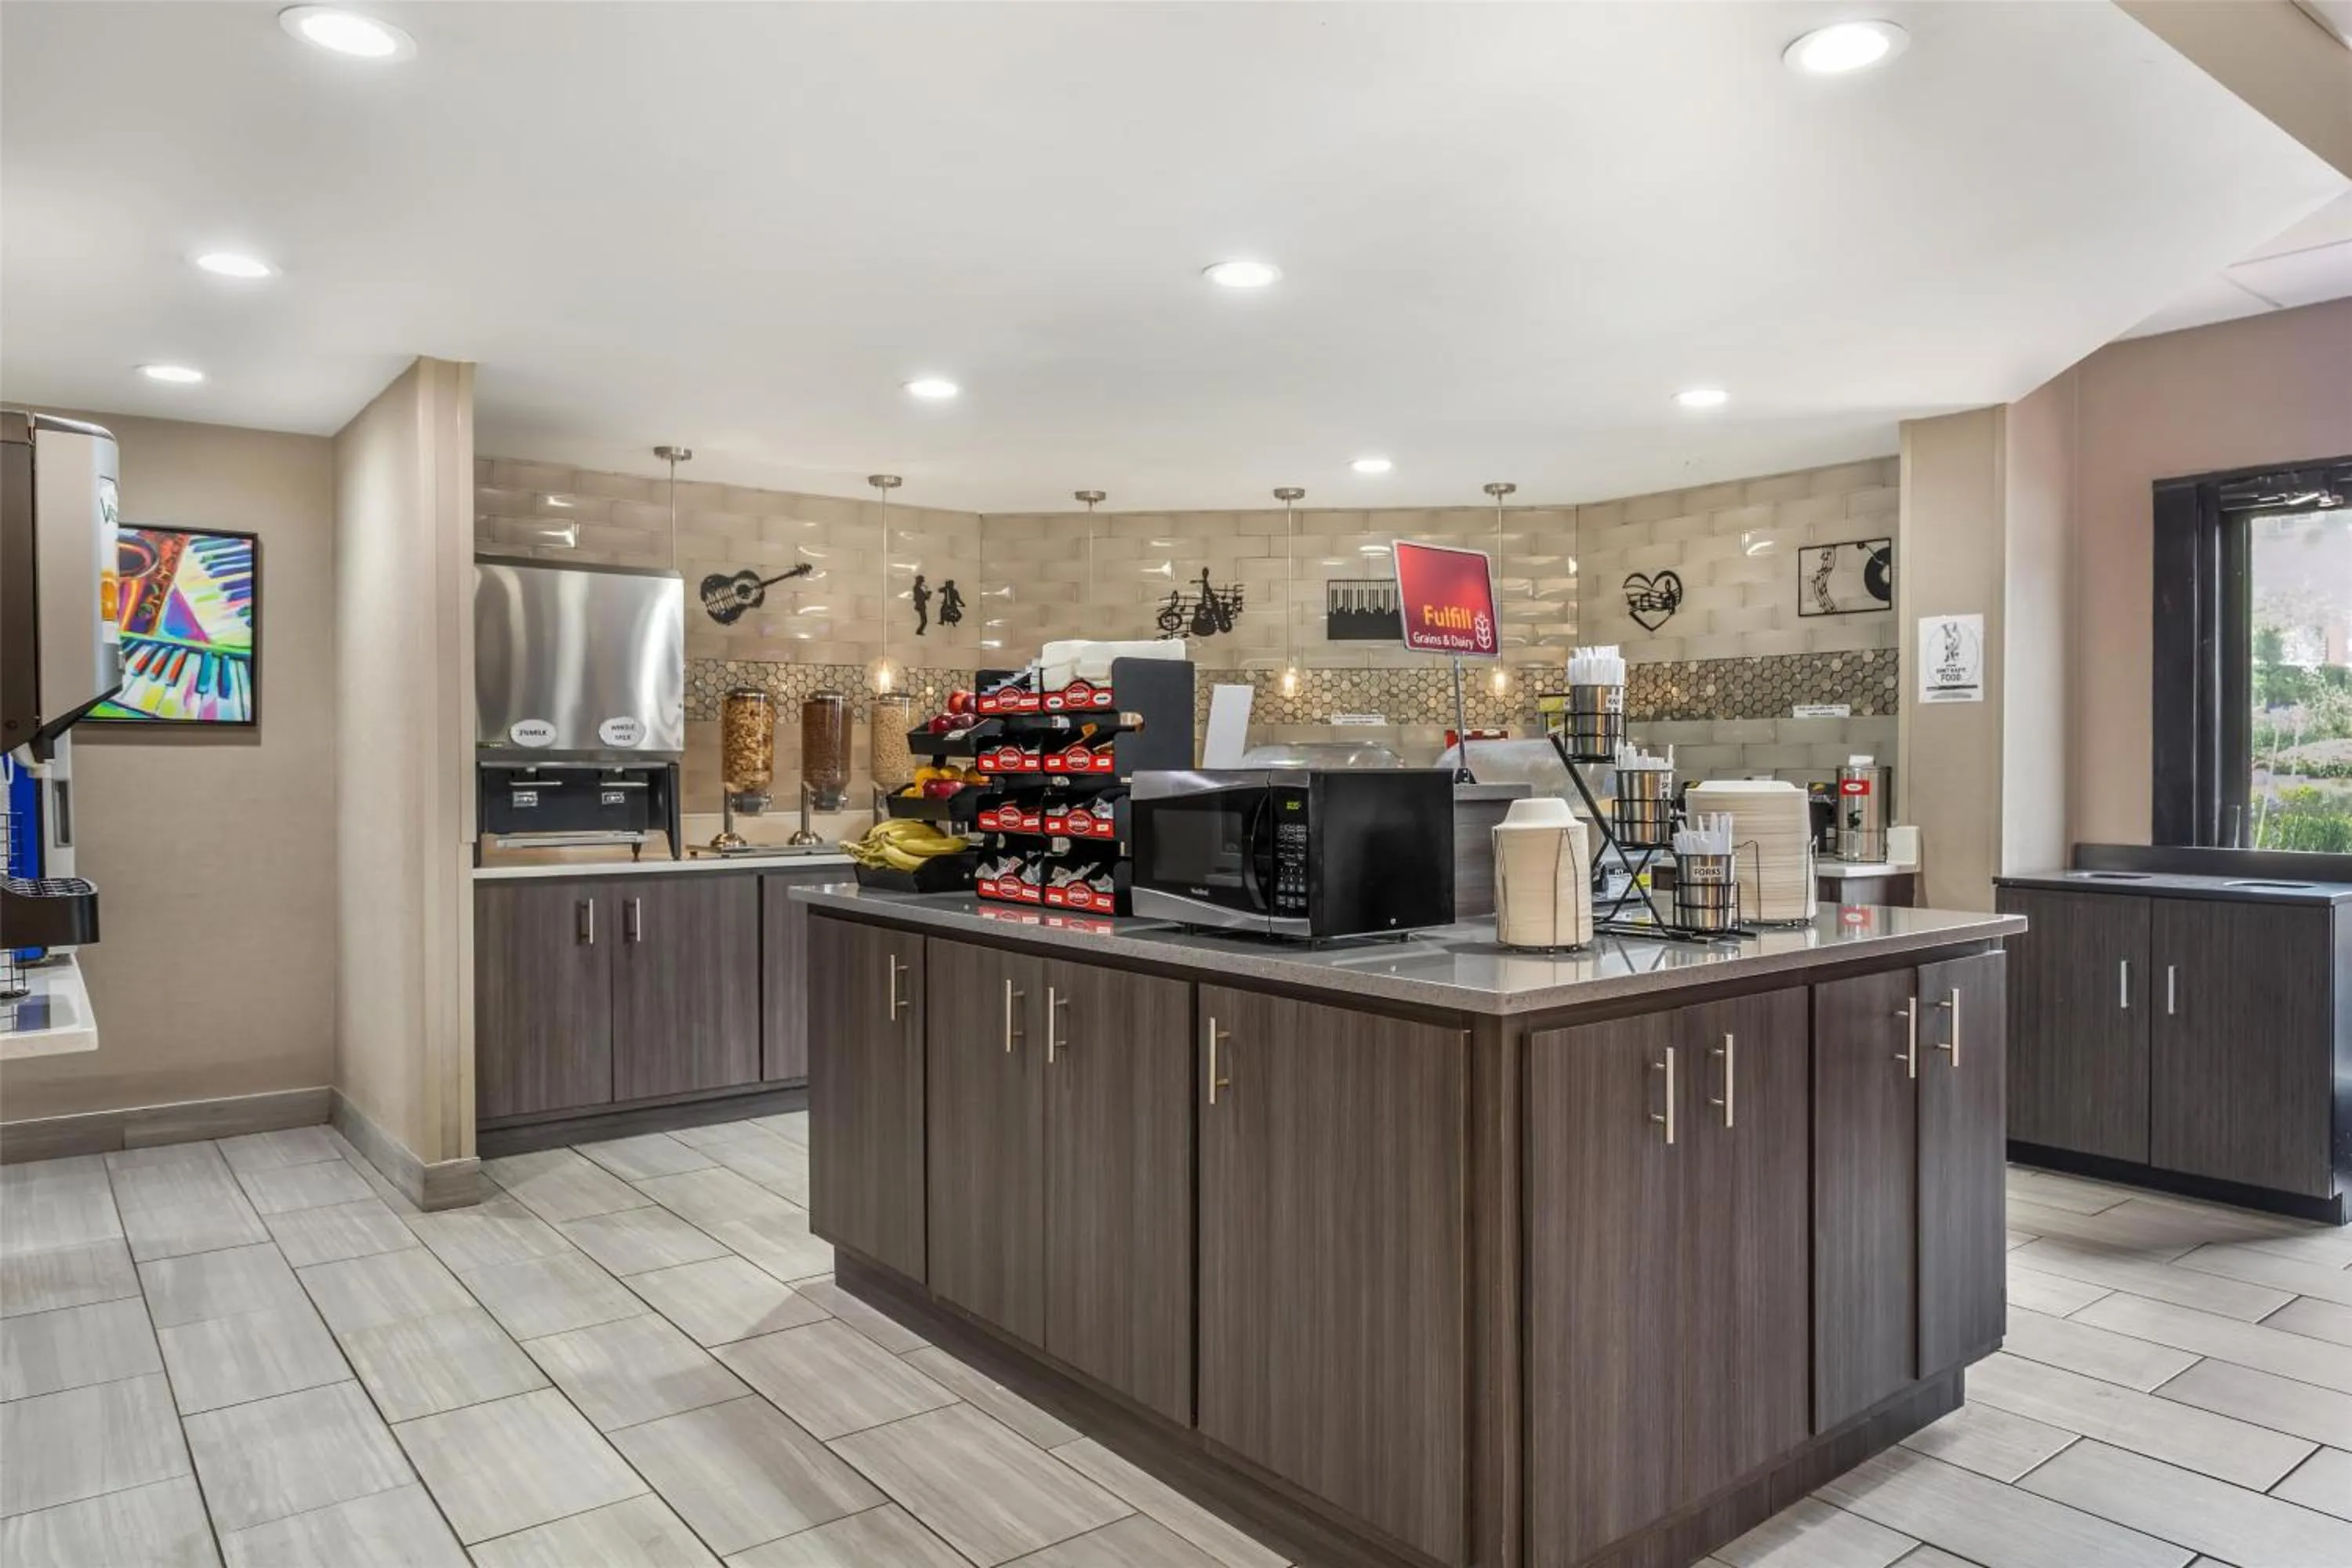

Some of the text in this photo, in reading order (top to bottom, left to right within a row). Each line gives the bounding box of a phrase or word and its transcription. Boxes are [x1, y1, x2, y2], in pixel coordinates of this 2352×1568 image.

[1423, 604, 1472, 630] Fulfill
[1413, 631, 1474, 651] Grains & Dairy
[1693, 867, 1722, 877] FORKS
